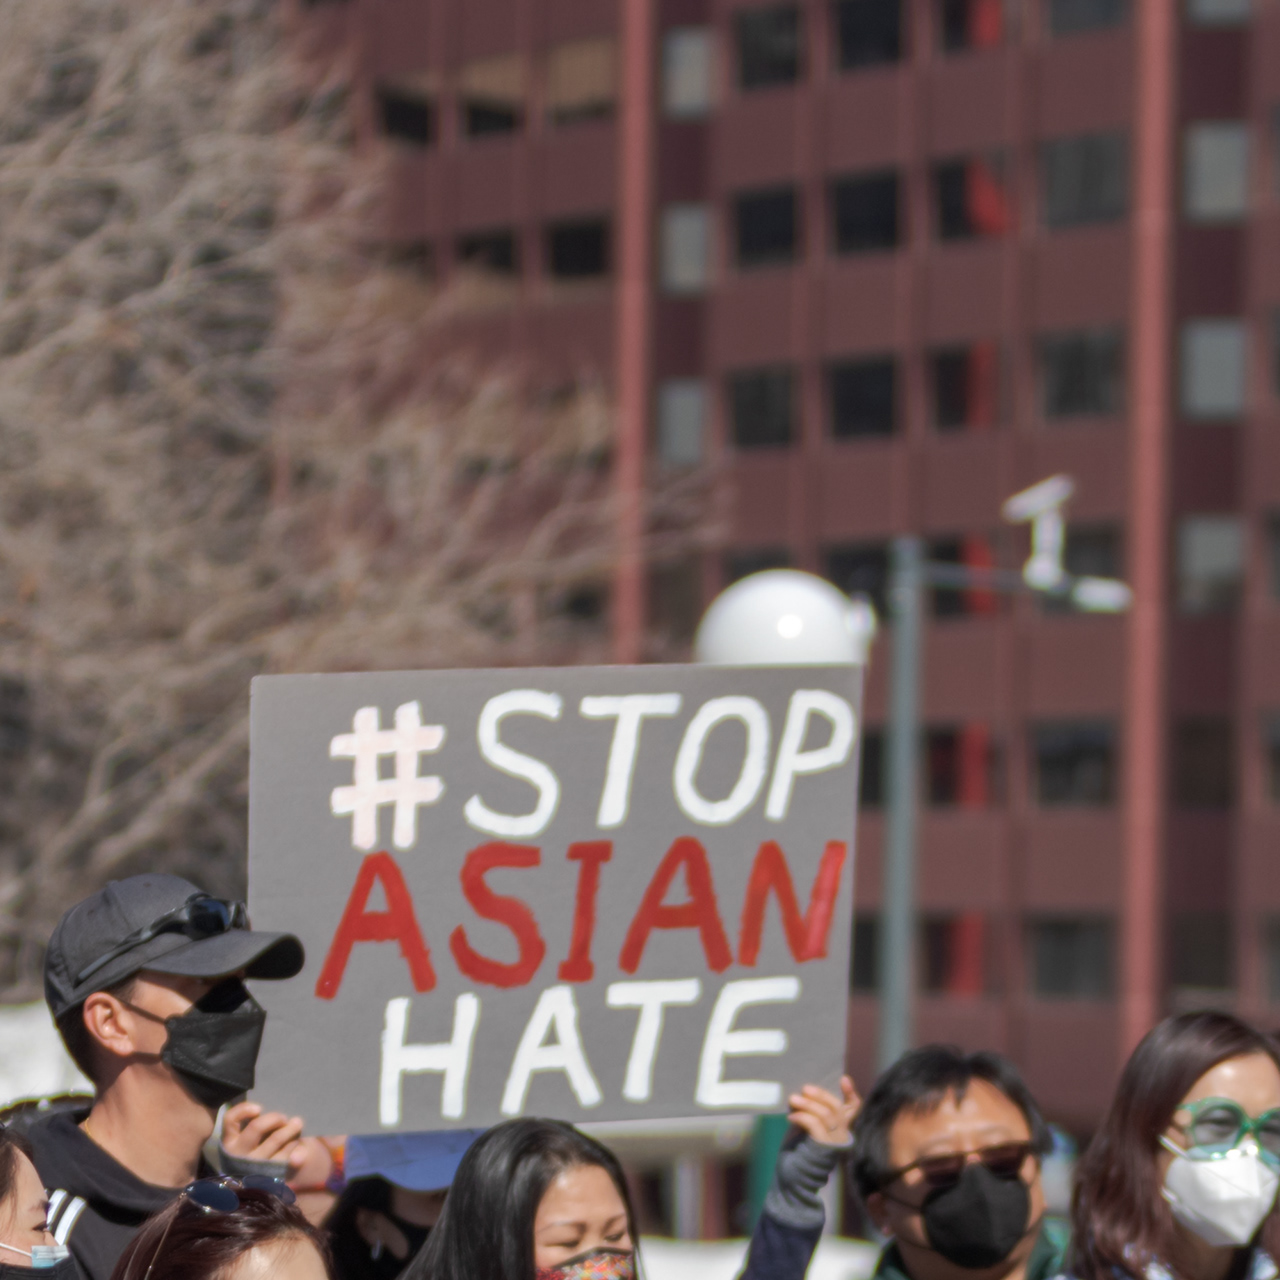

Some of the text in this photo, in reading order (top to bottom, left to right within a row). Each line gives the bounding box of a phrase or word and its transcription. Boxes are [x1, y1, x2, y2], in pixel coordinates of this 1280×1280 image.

[329, 688, 857, 851] #STOP
[314, 836, 848, 1001] ASIAN
[379, 976, 801, 1127] HATE
